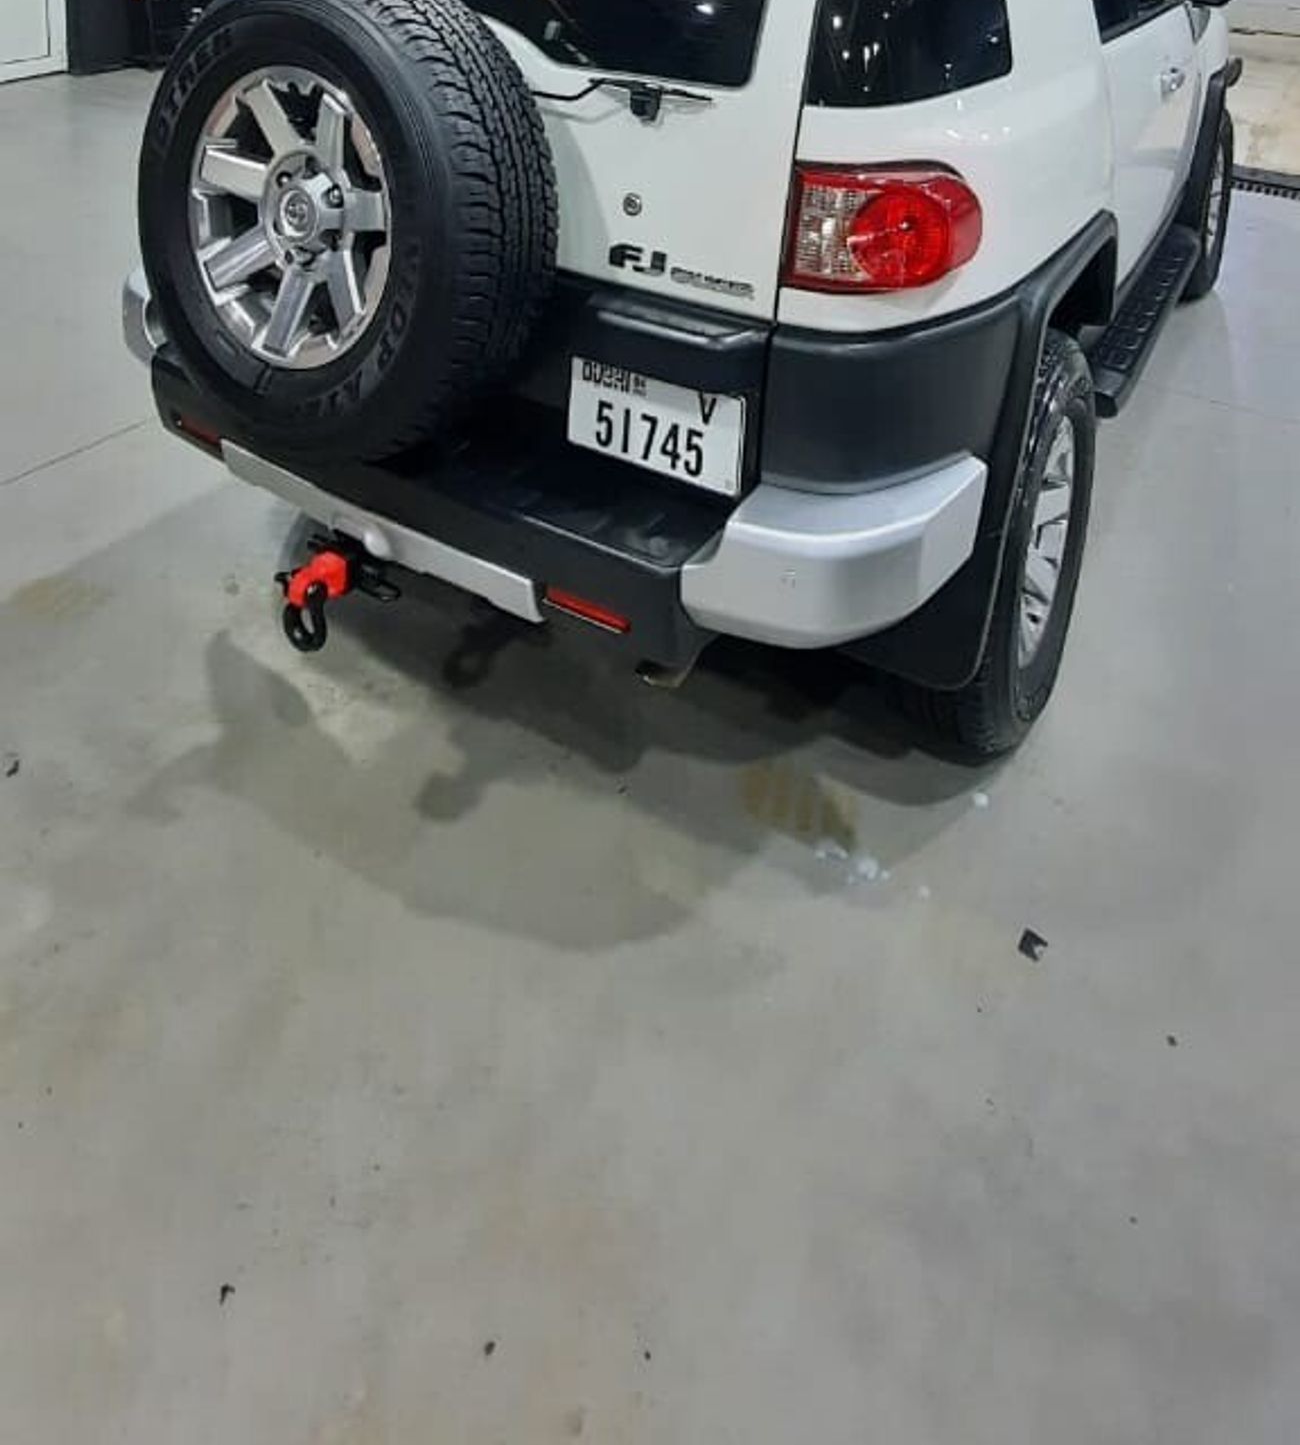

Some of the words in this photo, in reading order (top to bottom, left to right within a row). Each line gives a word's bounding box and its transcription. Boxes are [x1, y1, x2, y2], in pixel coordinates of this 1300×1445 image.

[609, 243, 667, 276] FJ
[697, 389, 717, 426] V
[595, 399, 704, 478] 51745
